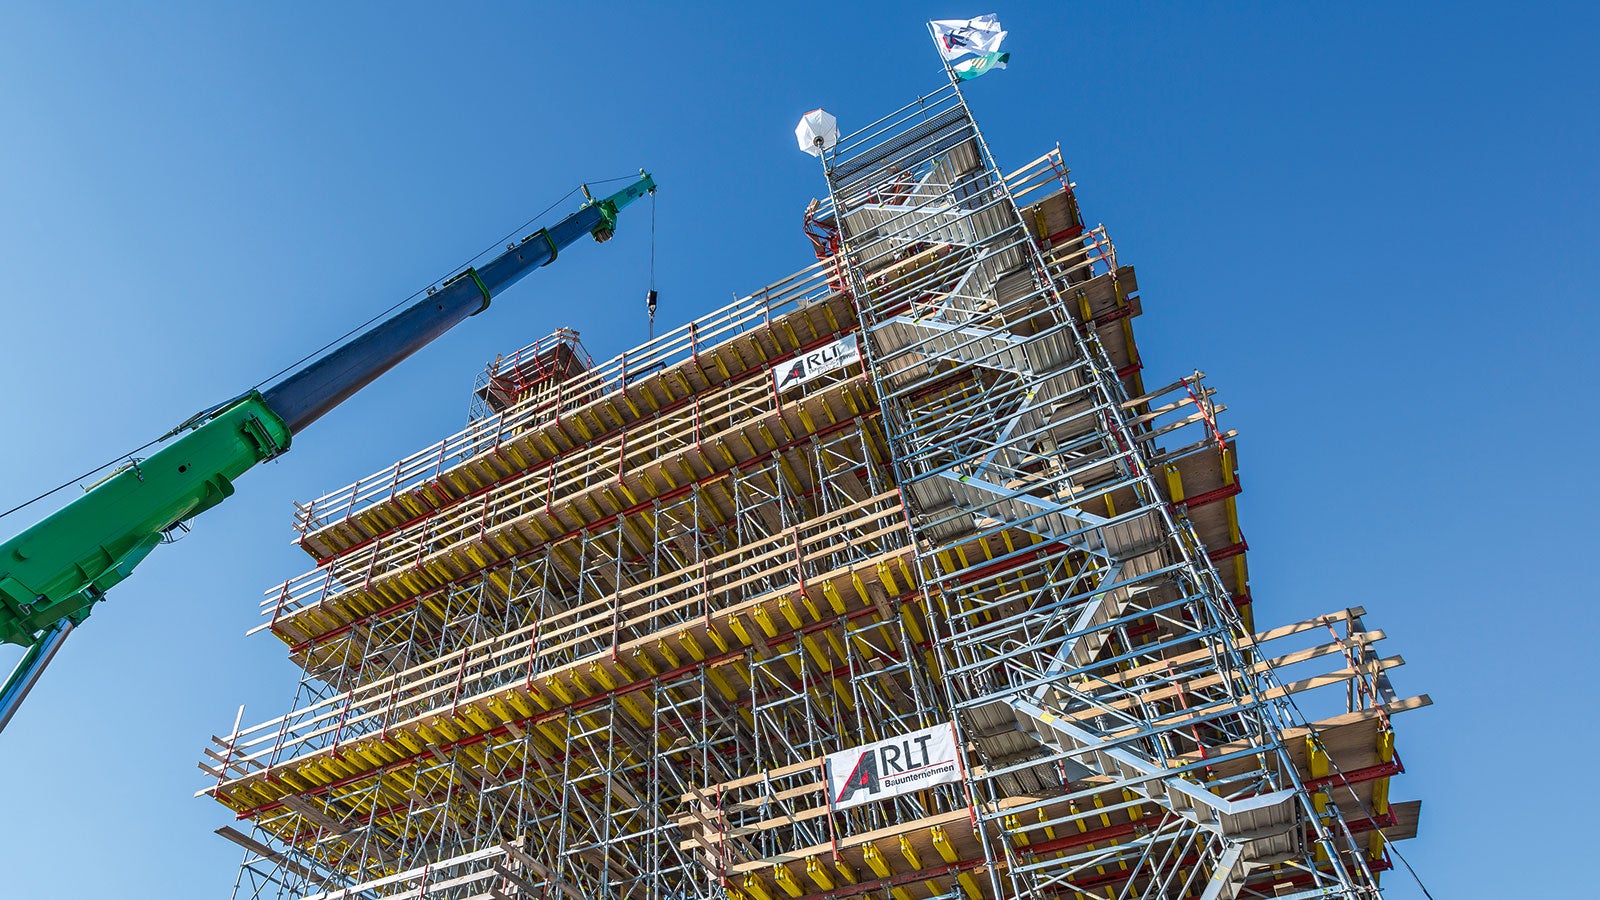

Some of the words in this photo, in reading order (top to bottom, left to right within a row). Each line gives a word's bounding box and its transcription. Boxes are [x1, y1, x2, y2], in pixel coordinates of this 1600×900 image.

[780, 343, 840, 388] ARLT
[836, 734, 931, 803] ARLT
[885, 764, 954, 788] Bauunternehmen
